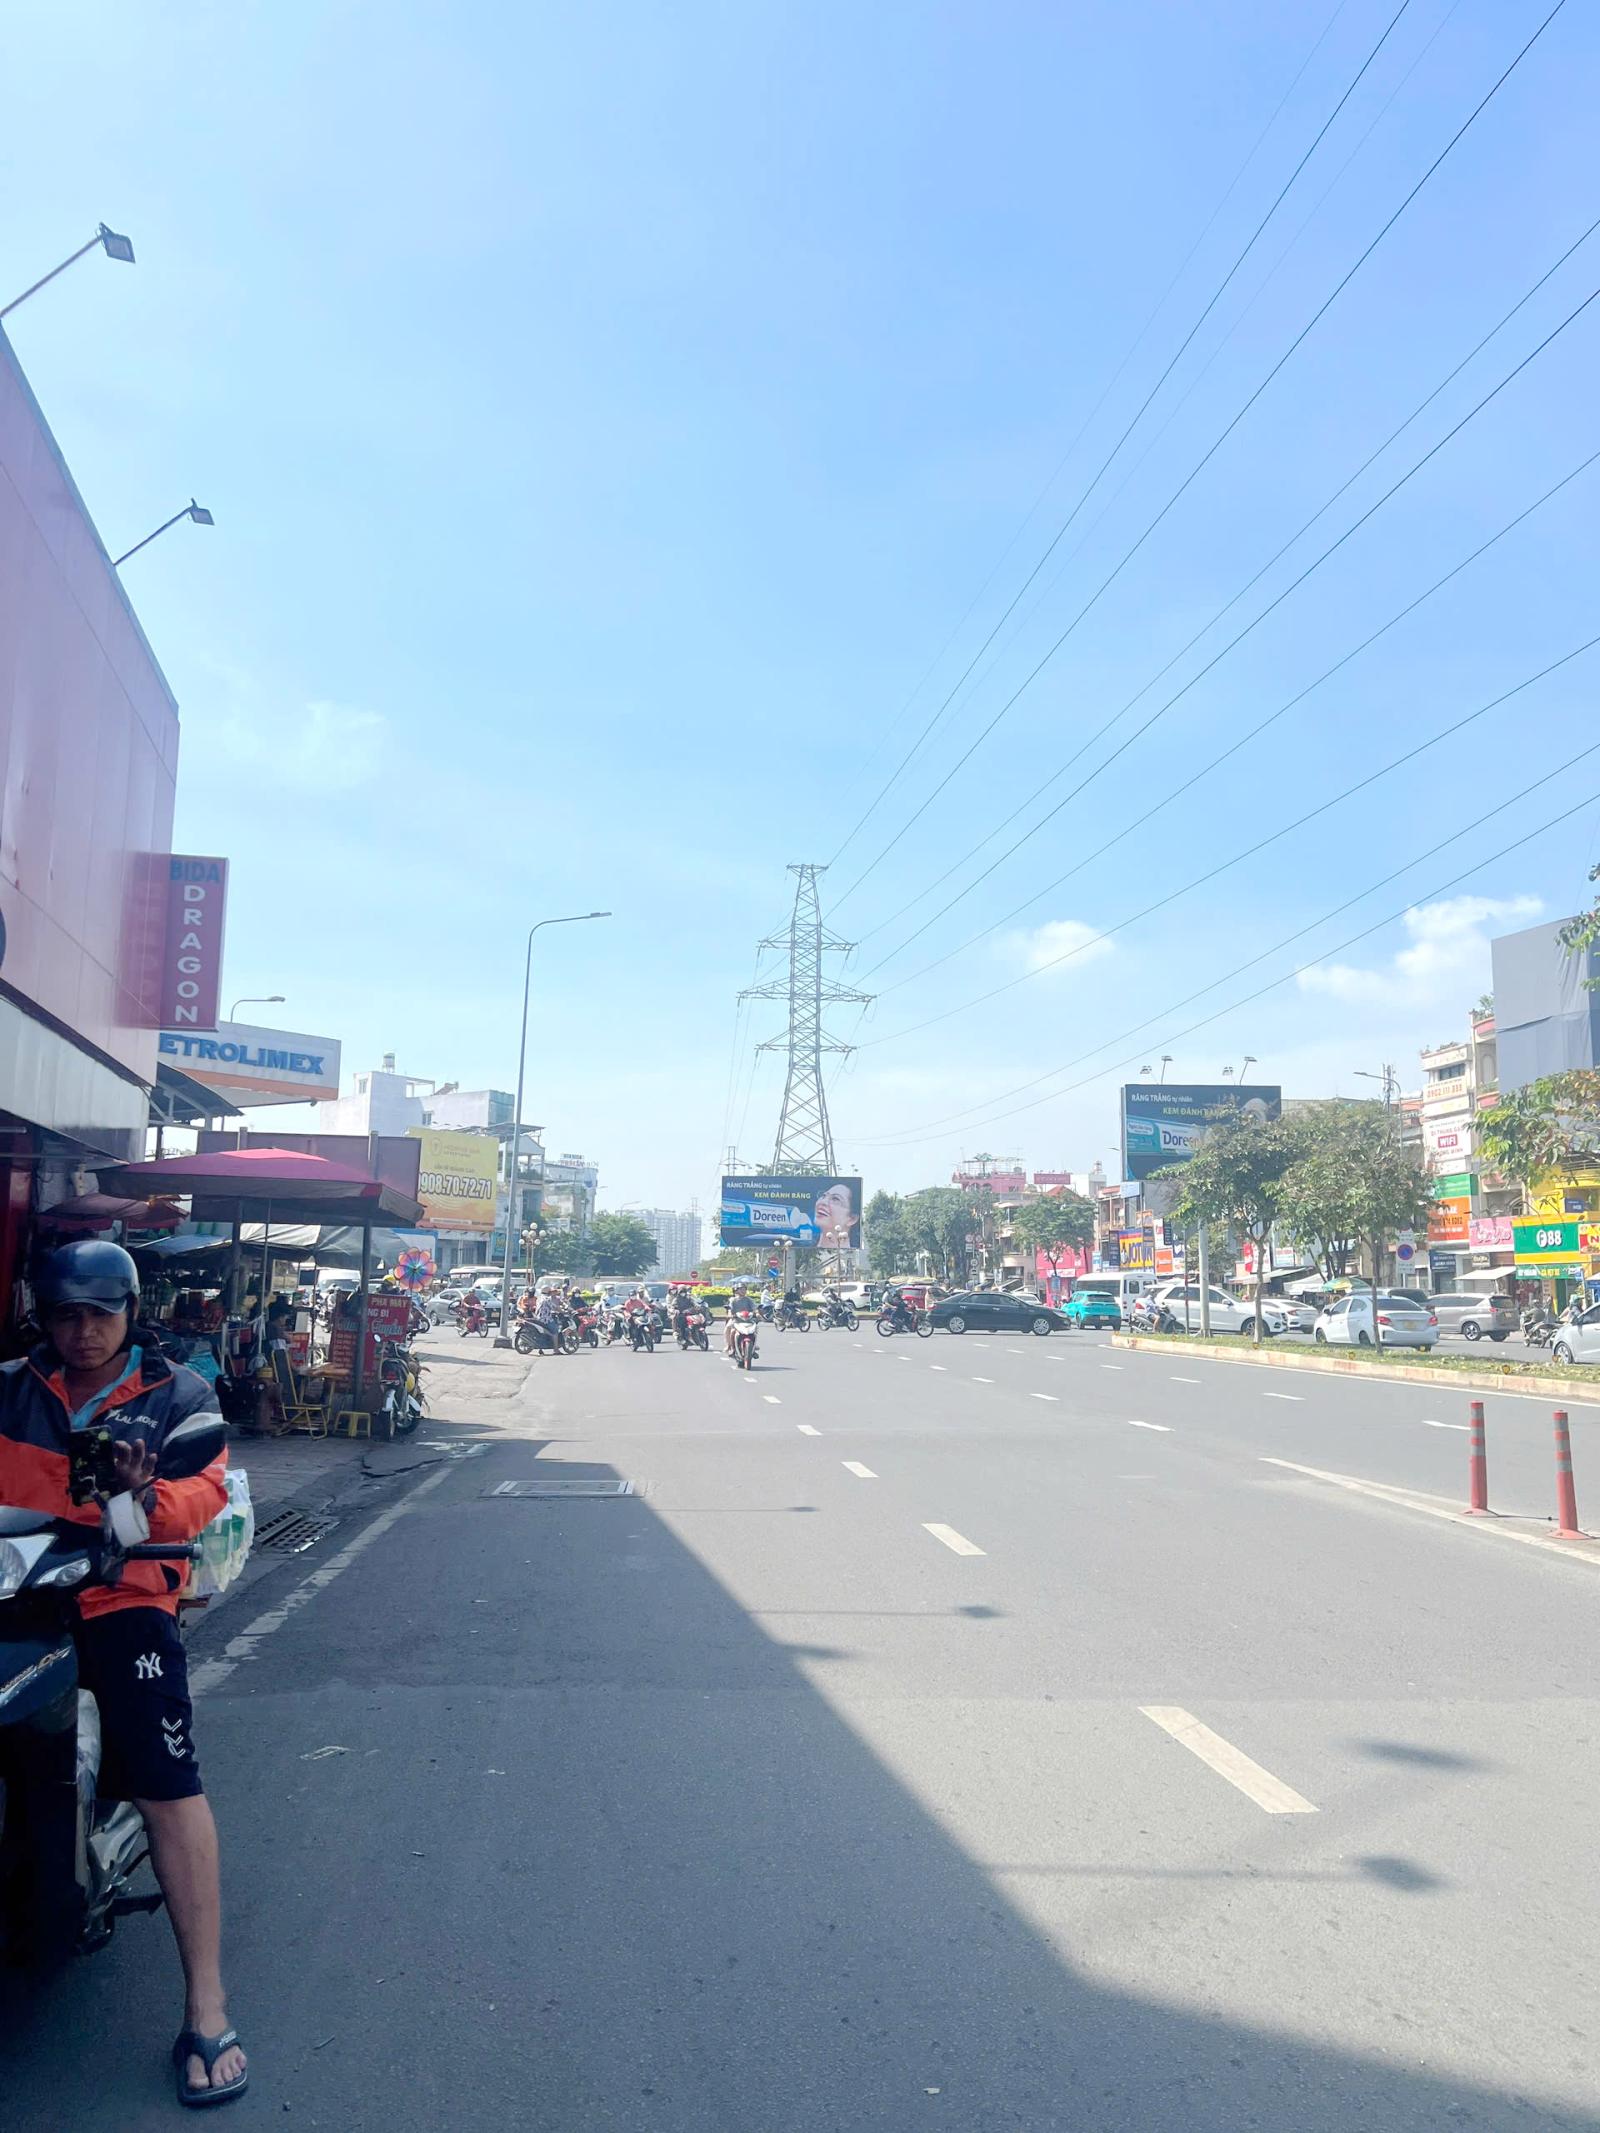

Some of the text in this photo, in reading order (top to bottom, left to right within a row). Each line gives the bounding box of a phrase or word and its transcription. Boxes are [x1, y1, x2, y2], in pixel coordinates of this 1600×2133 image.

[170, 860, 220, 883] BIDA
[175, 884, 206, 1023] DRAGON
[158, 1032, 325, 1075] ETROLIMEX
[1163, 1107, 1179, 1115] KEM
[1162, 1130, 1200, 1147] Dore
[419, 1172, 492, 1199] 908.70.72.71
[753, 1209, 786, 1222] Doreen
[1536, 1229, 1563, 1248] F88
[1129, 1241, 1154, 1264] JOTUN
[114, 1414, 159, 1429] LALMOVE
